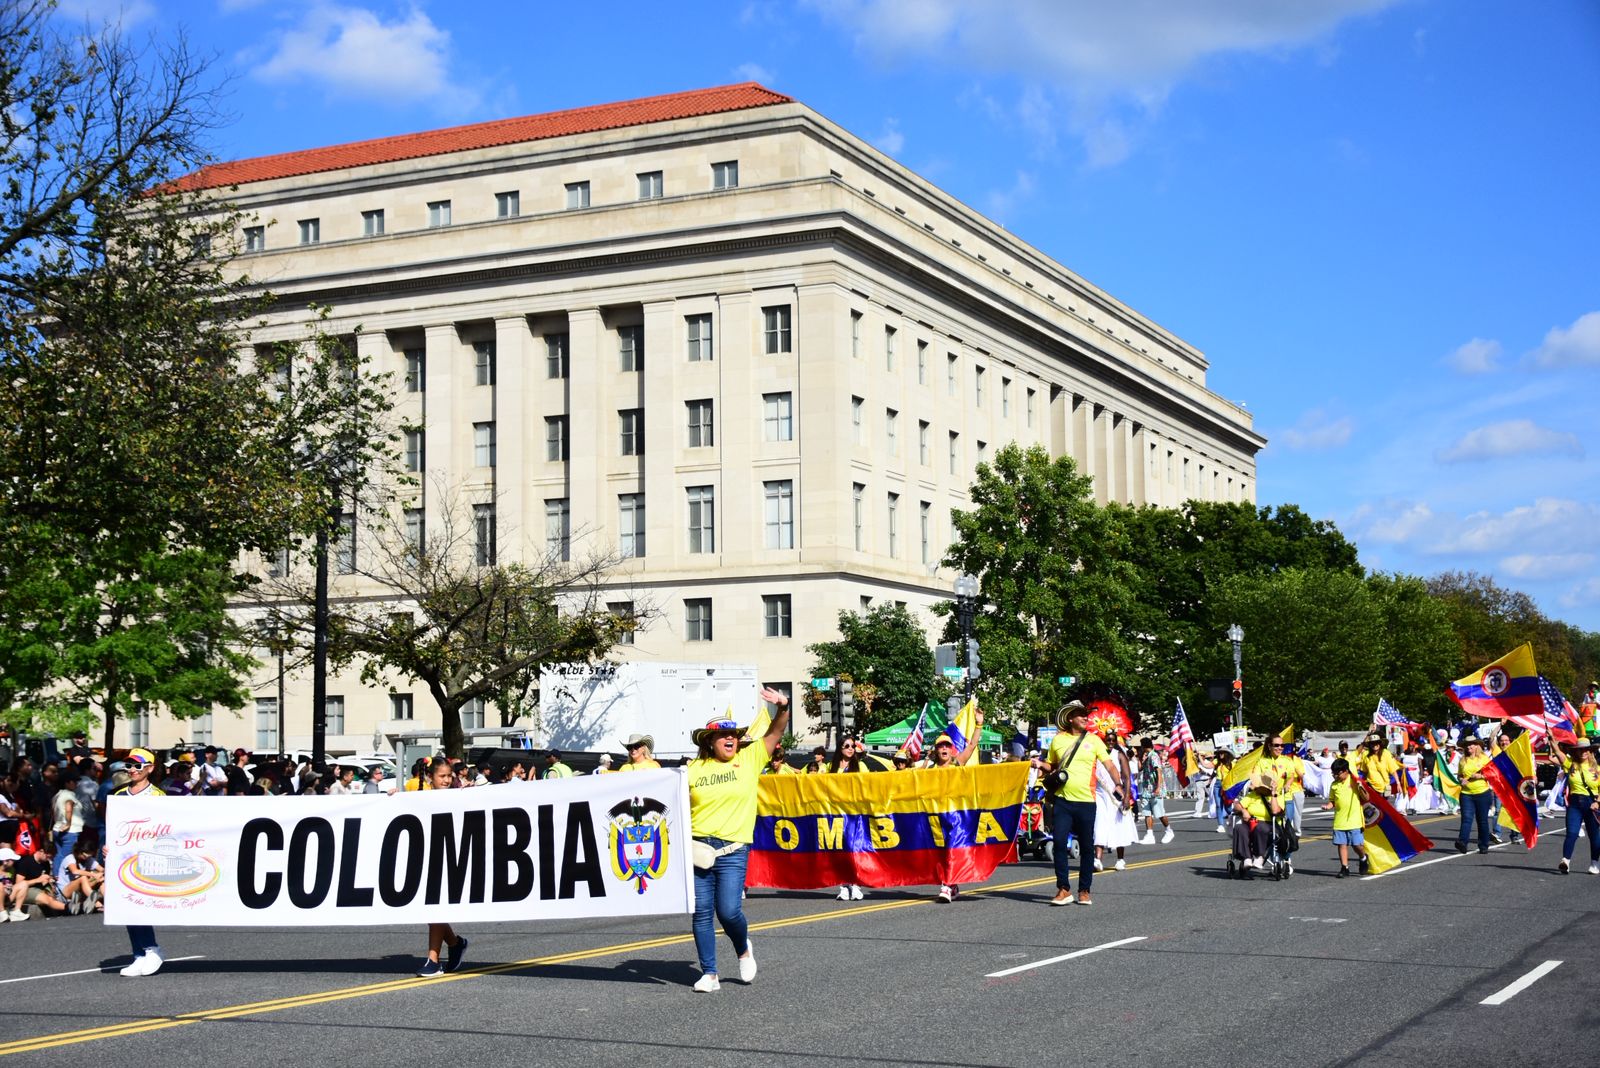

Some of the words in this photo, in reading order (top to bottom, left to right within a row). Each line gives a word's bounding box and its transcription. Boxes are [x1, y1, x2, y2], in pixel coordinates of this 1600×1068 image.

[694, 770, 738, 788] COLOMBIA
[115, 817, 172, 846] Fiesta
[184, 838, 206, 849] DC
[236, 800, 607, 910] COLOMBIA
[179, 894, 208, 911] Capital
